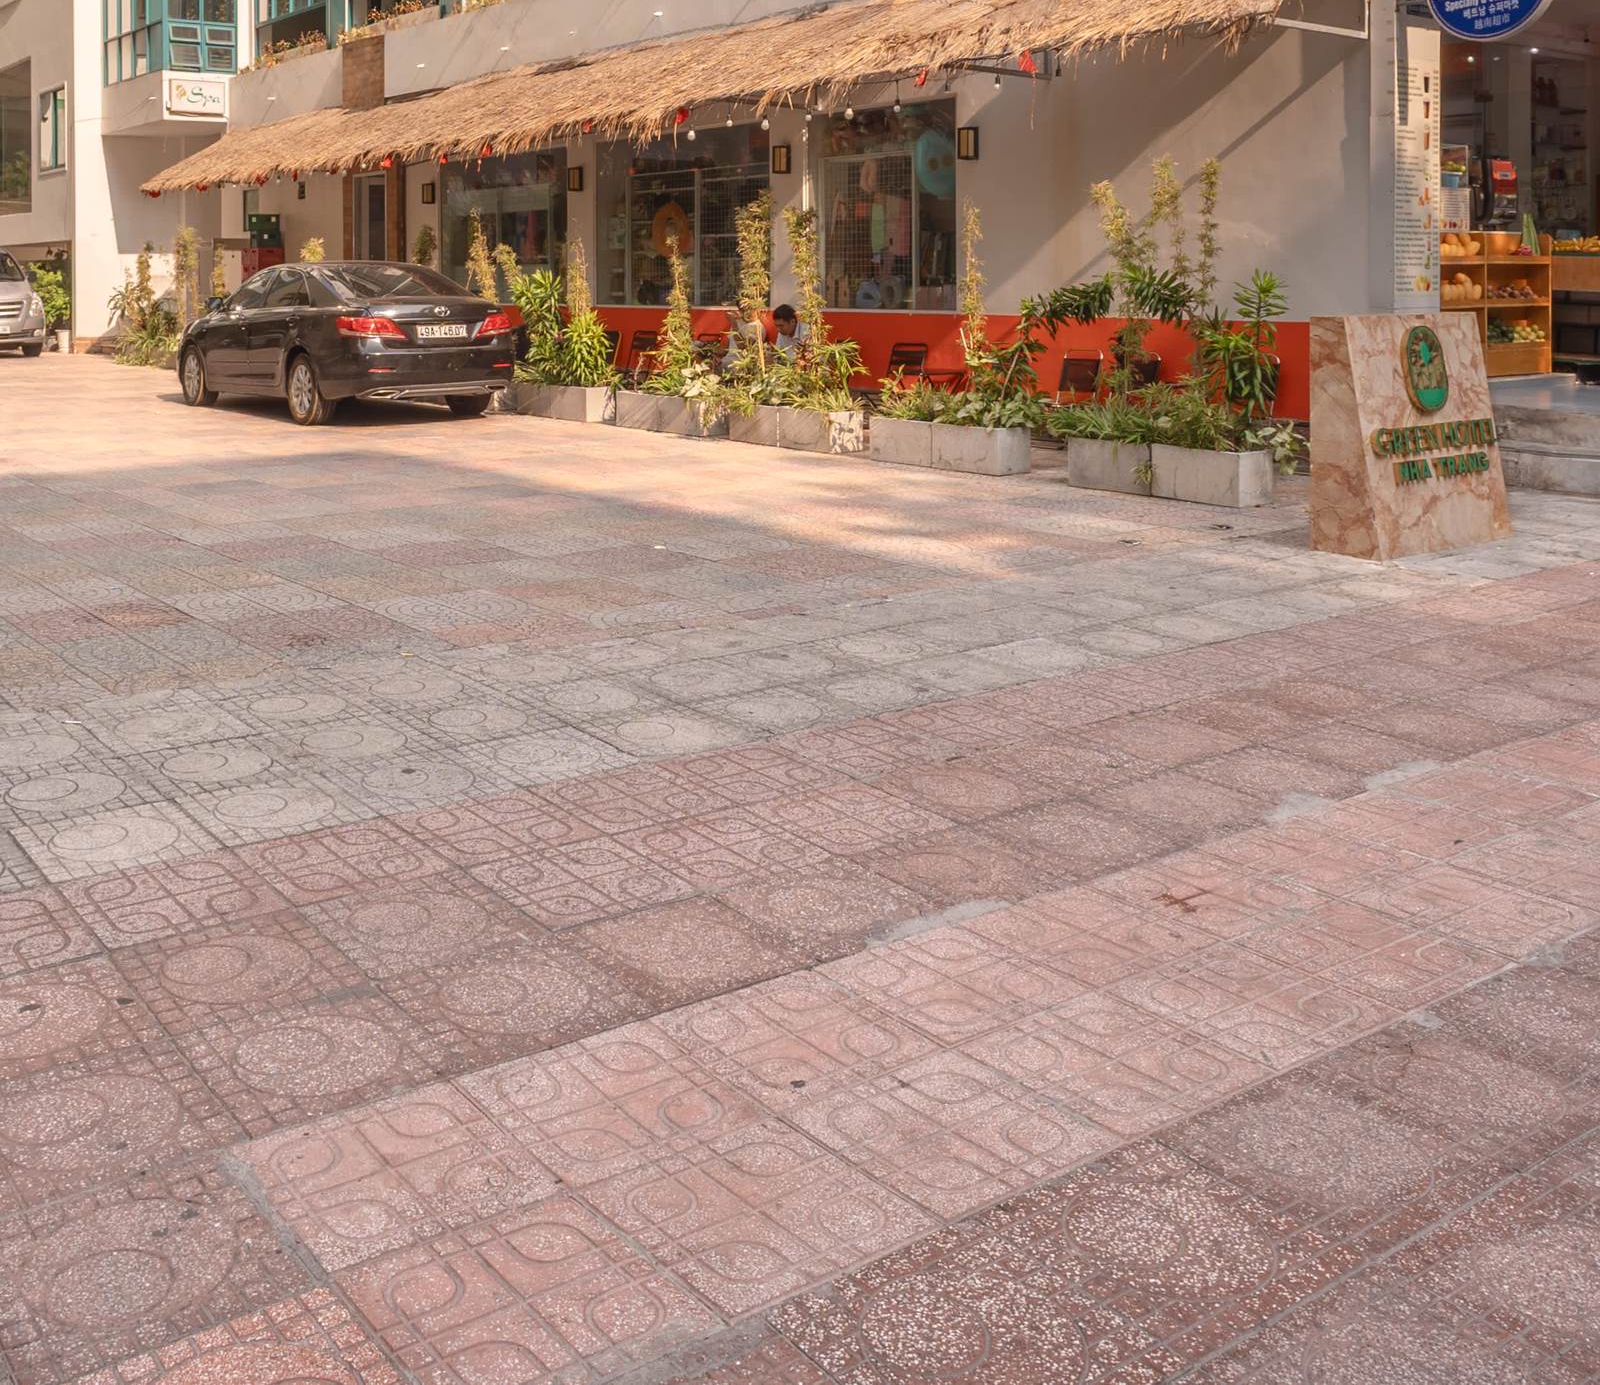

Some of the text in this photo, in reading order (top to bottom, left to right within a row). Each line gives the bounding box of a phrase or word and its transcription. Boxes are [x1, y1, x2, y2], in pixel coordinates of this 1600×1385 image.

[187, 85, 220, 109] Spa
[1372, 418, 1497, 457] GREEN HOTEL
[1395, 451, 1490, 485] NHA TRANG
